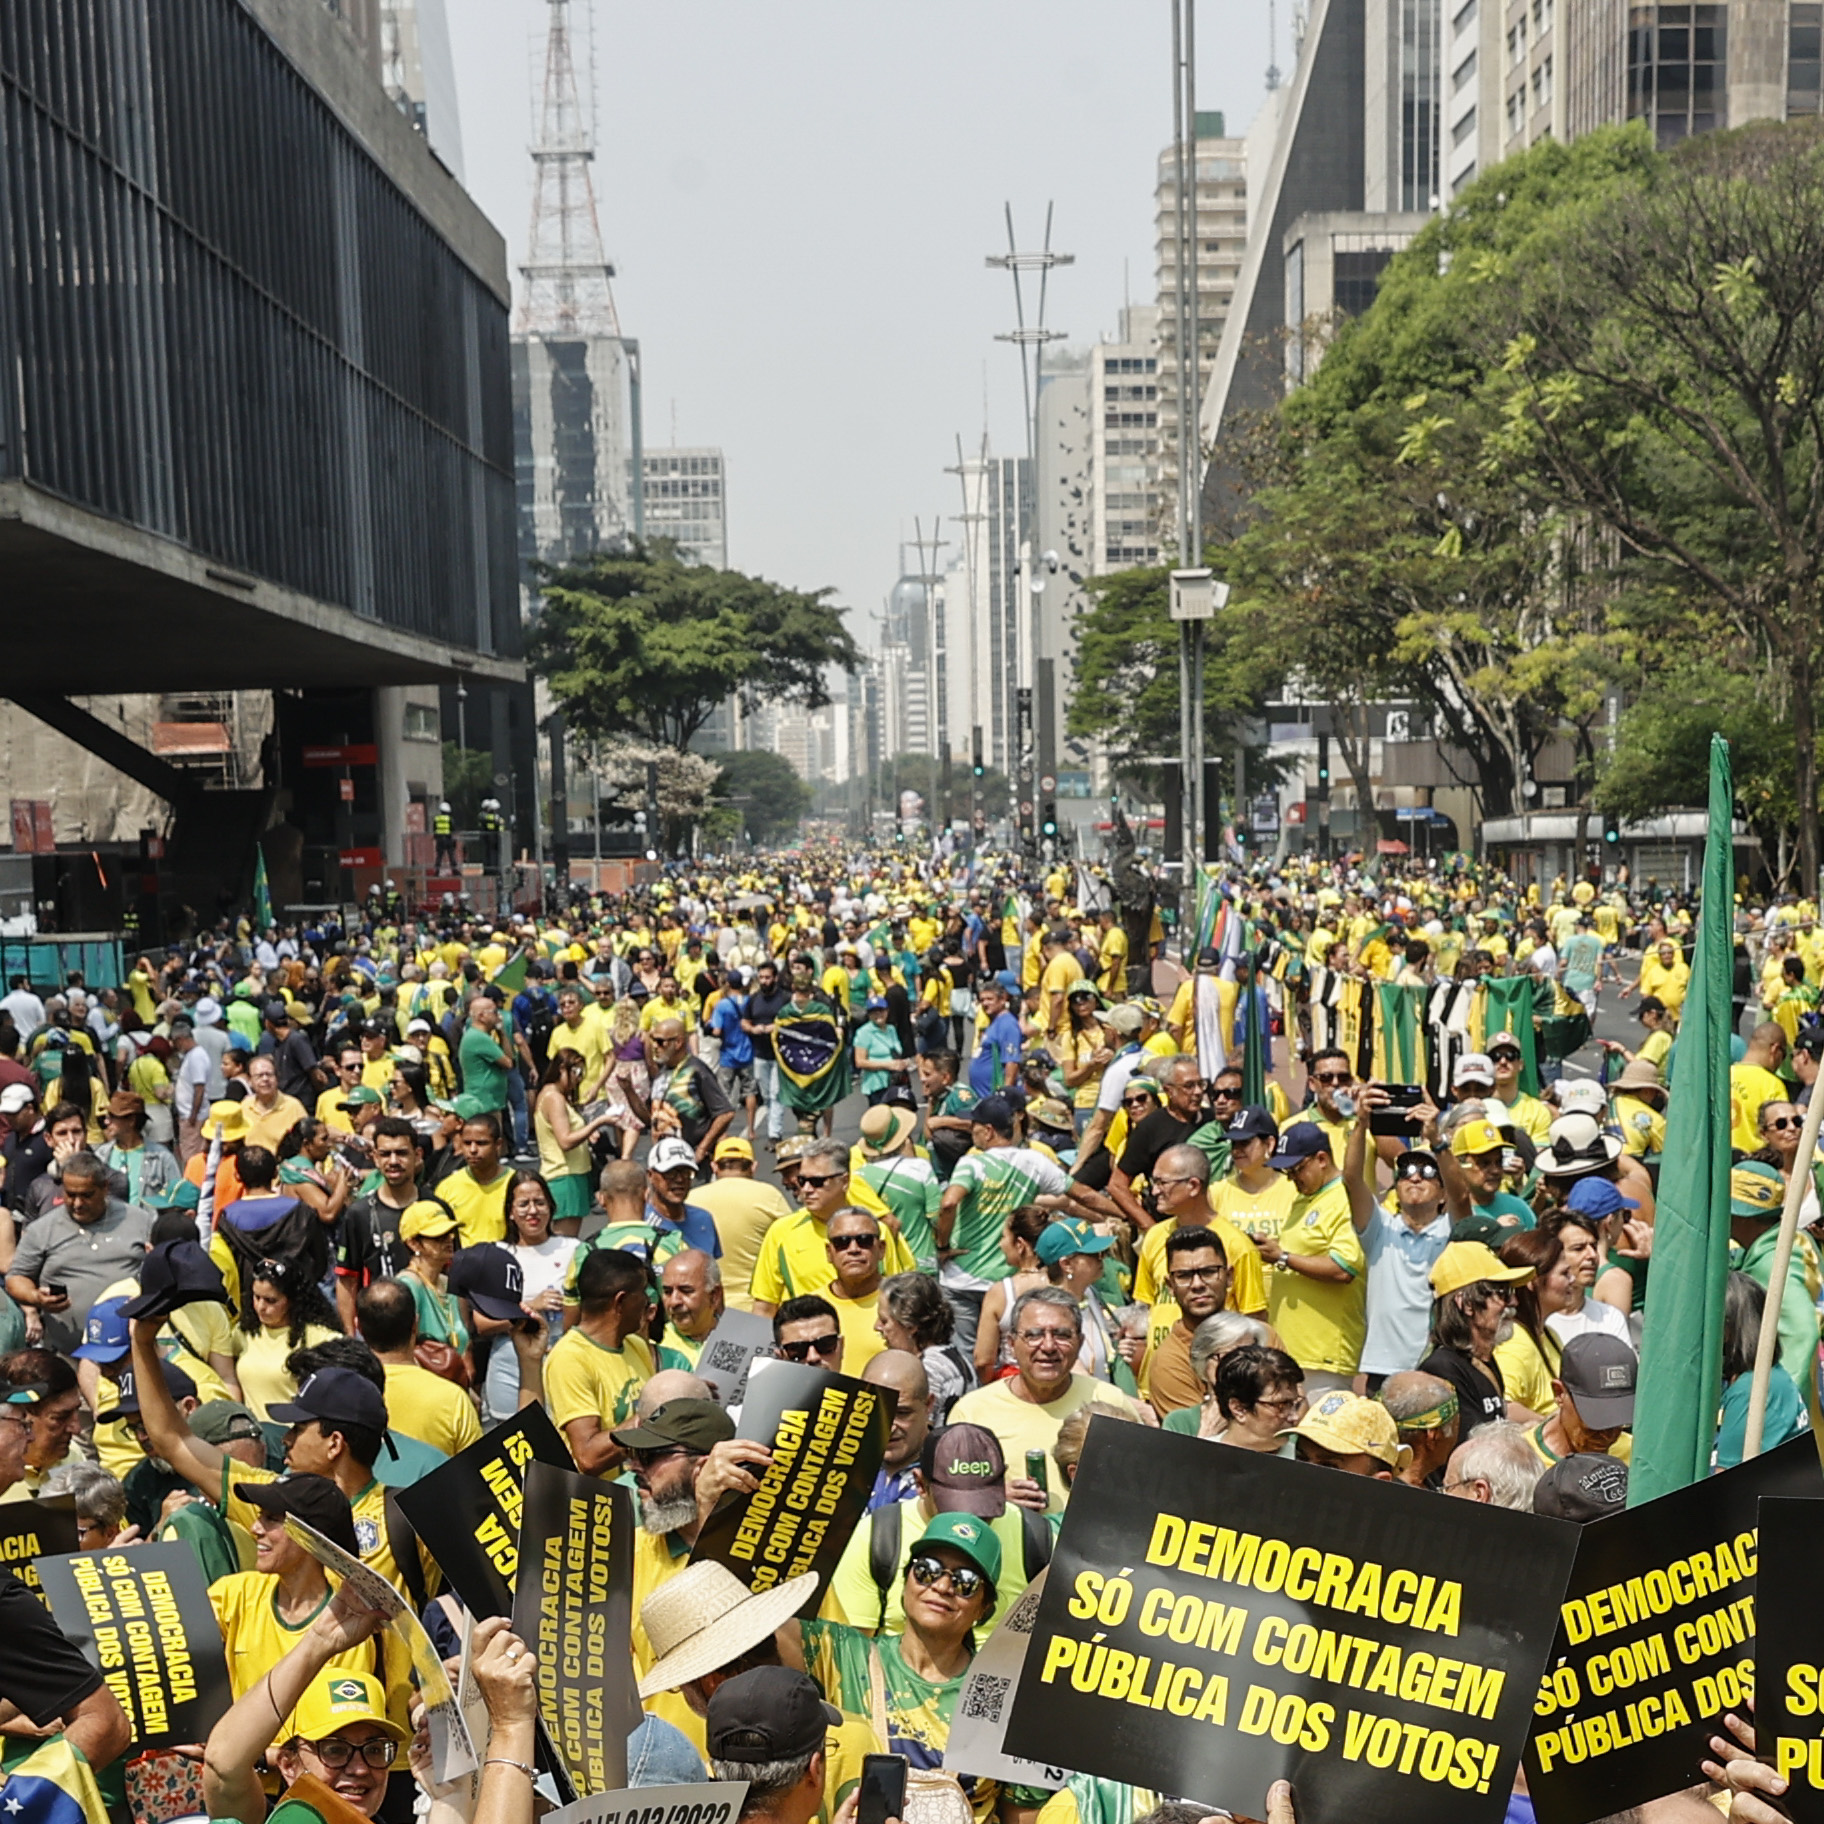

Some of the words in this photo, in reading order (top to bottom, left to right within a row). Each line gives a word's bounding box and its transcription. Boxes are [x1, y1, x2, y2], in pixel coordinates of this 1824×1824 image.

[729, 1409, 810, 1561] DEMOCRACIA
[763, 1511, 802, 1564] COM
[785, 1386, 849, 1511] CONTAGEM
[815, 1469, 848, 1516] DOS
[833, 1390, 876, 1467] VOTOS!
[102, 1555, 136, 1577] SÓ
[111, 1578, 145, 1618] COM
[563, 1498, 588, 1678] CONTAGEM
[589, 1493, 613, 1604] VOTOS!
[1144, 1511, 1466, 1638] DEMOCRACIA
[69, 1556, 114, 1625] PÚBLICA
[94, 1626, 125, 1668] DOS
[140, 1570, 198, 1705] DEMOCRACIA
[587, 1612, 605, 1678] DOS
[1066, 1566, 1135, 1628] SÓ
[1138, 1586, 1248, 1657] COM
[1250, 1616, 1507, 1721] CONTAGEM
[125, 1620, 170, 1735] CONTAGEM
[1040, 1632, 1230, 1728] PÚBLICA
[1236, 1684, 1336, 1755] DOS
[1341, 1709, 1500, 1795] VOTOS!
[1532, 1657, 1581, 1719] SÓ
[1585, 1633, 1671, 1700] COM
[1534, 1683, 1690, 1776] PÚBLICA
